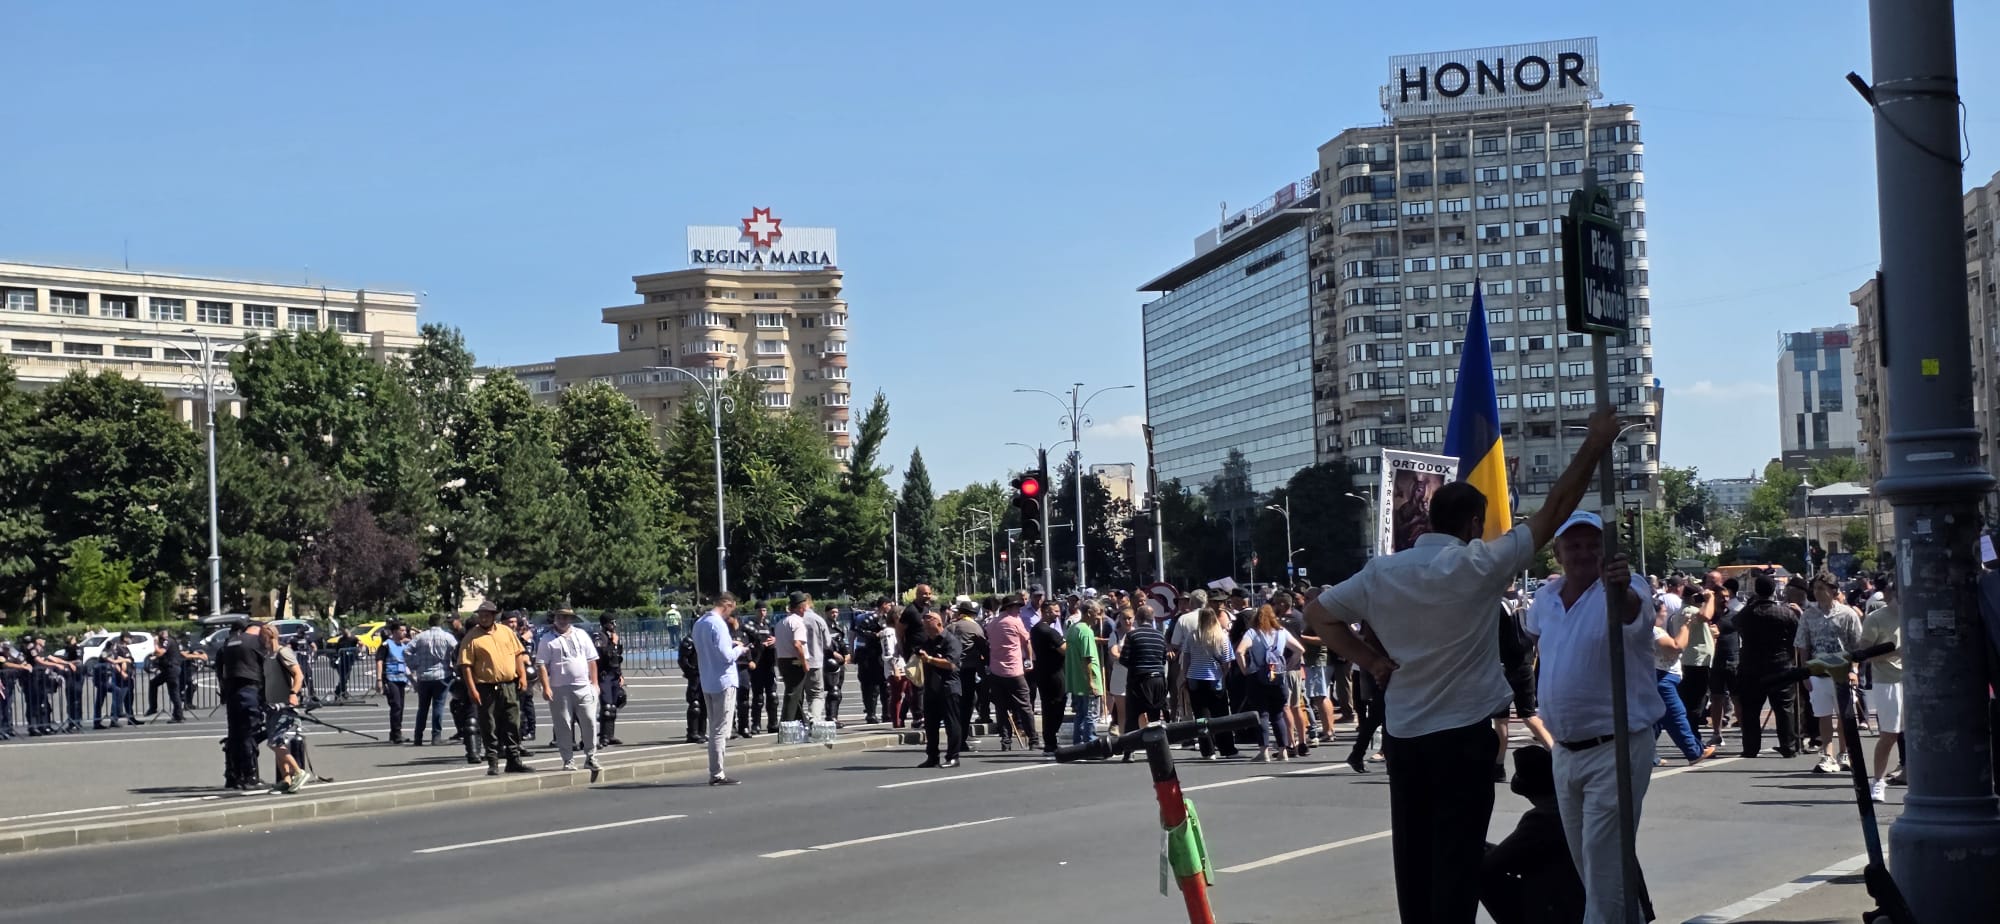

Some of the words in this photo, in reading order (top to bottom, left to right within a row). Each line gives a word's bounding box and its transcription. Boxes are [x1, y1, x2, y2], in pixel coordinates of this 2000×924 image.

[1400, 52, 1587, 102] HONOR
[693, 250, 764, 264] REGINA
[770, 251, 831, 264] MARIA
[1393, 460, 1450, 474] ORTODOX
